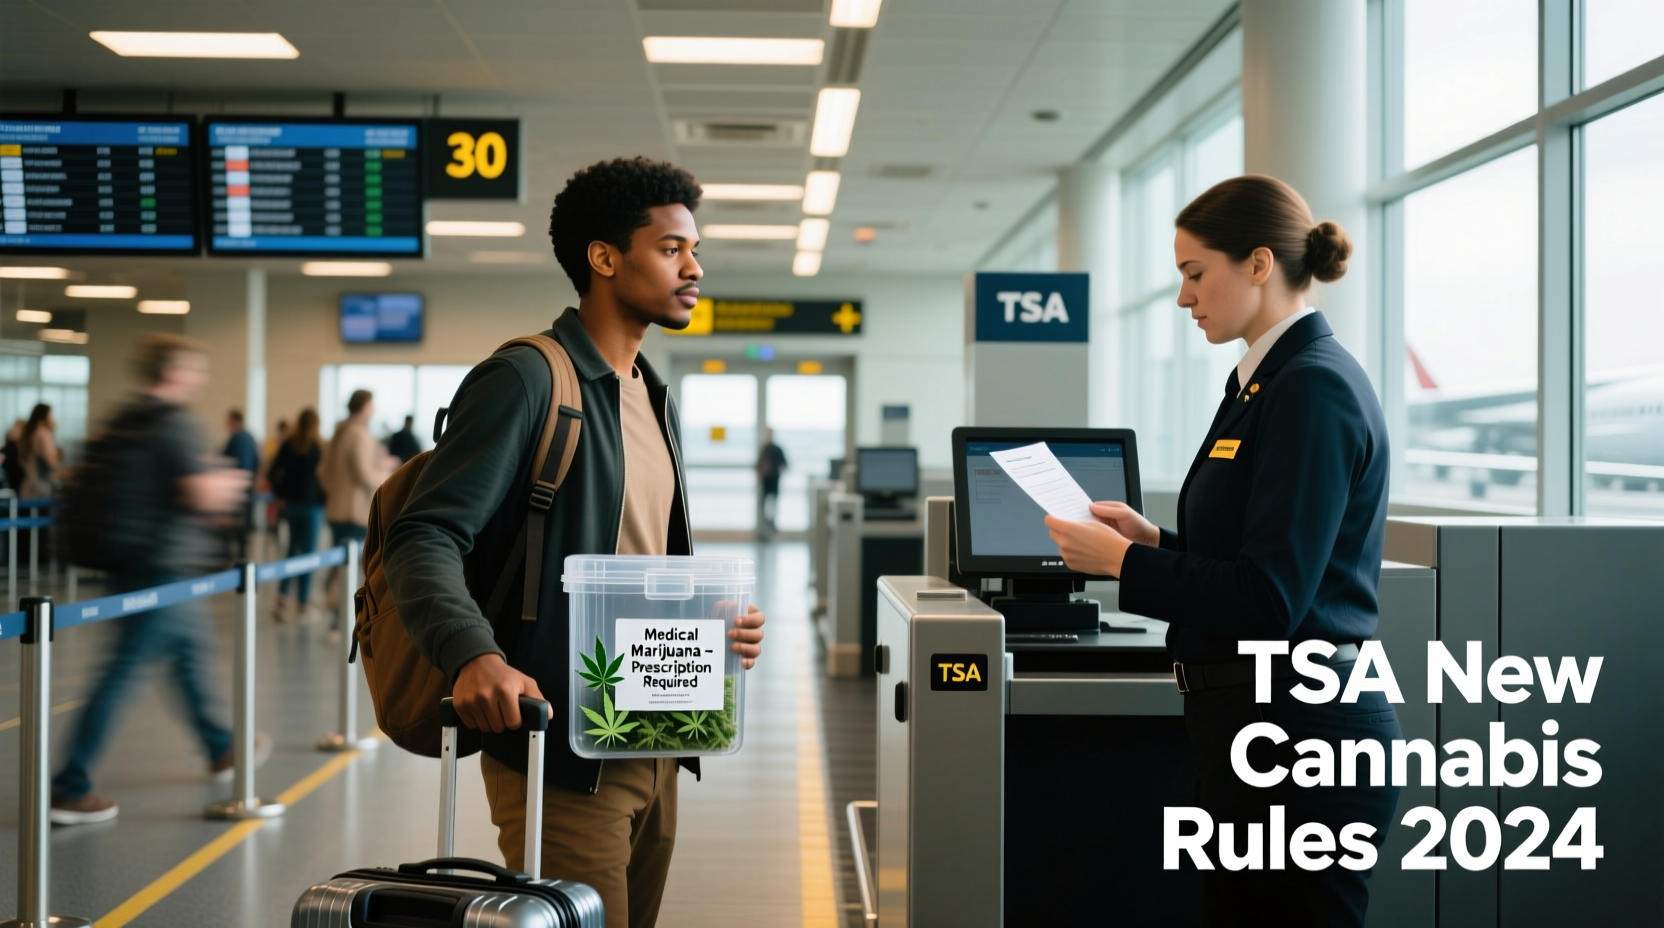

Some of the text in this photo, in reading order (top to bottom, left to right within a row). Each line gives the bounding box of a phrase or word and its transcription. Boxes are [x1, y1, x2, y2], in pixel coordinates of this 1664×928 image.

[445, 131, 507, 179] 30
[996, 291, 1069, 324] TSA
[644, 627, 698, 641] Medical
[631, 643, 701, 661] Marijuana
[631, 660, 712, 676] Prescription
[938, 662, 982, 682] TSA
[643, 675, 698, 690] Required
